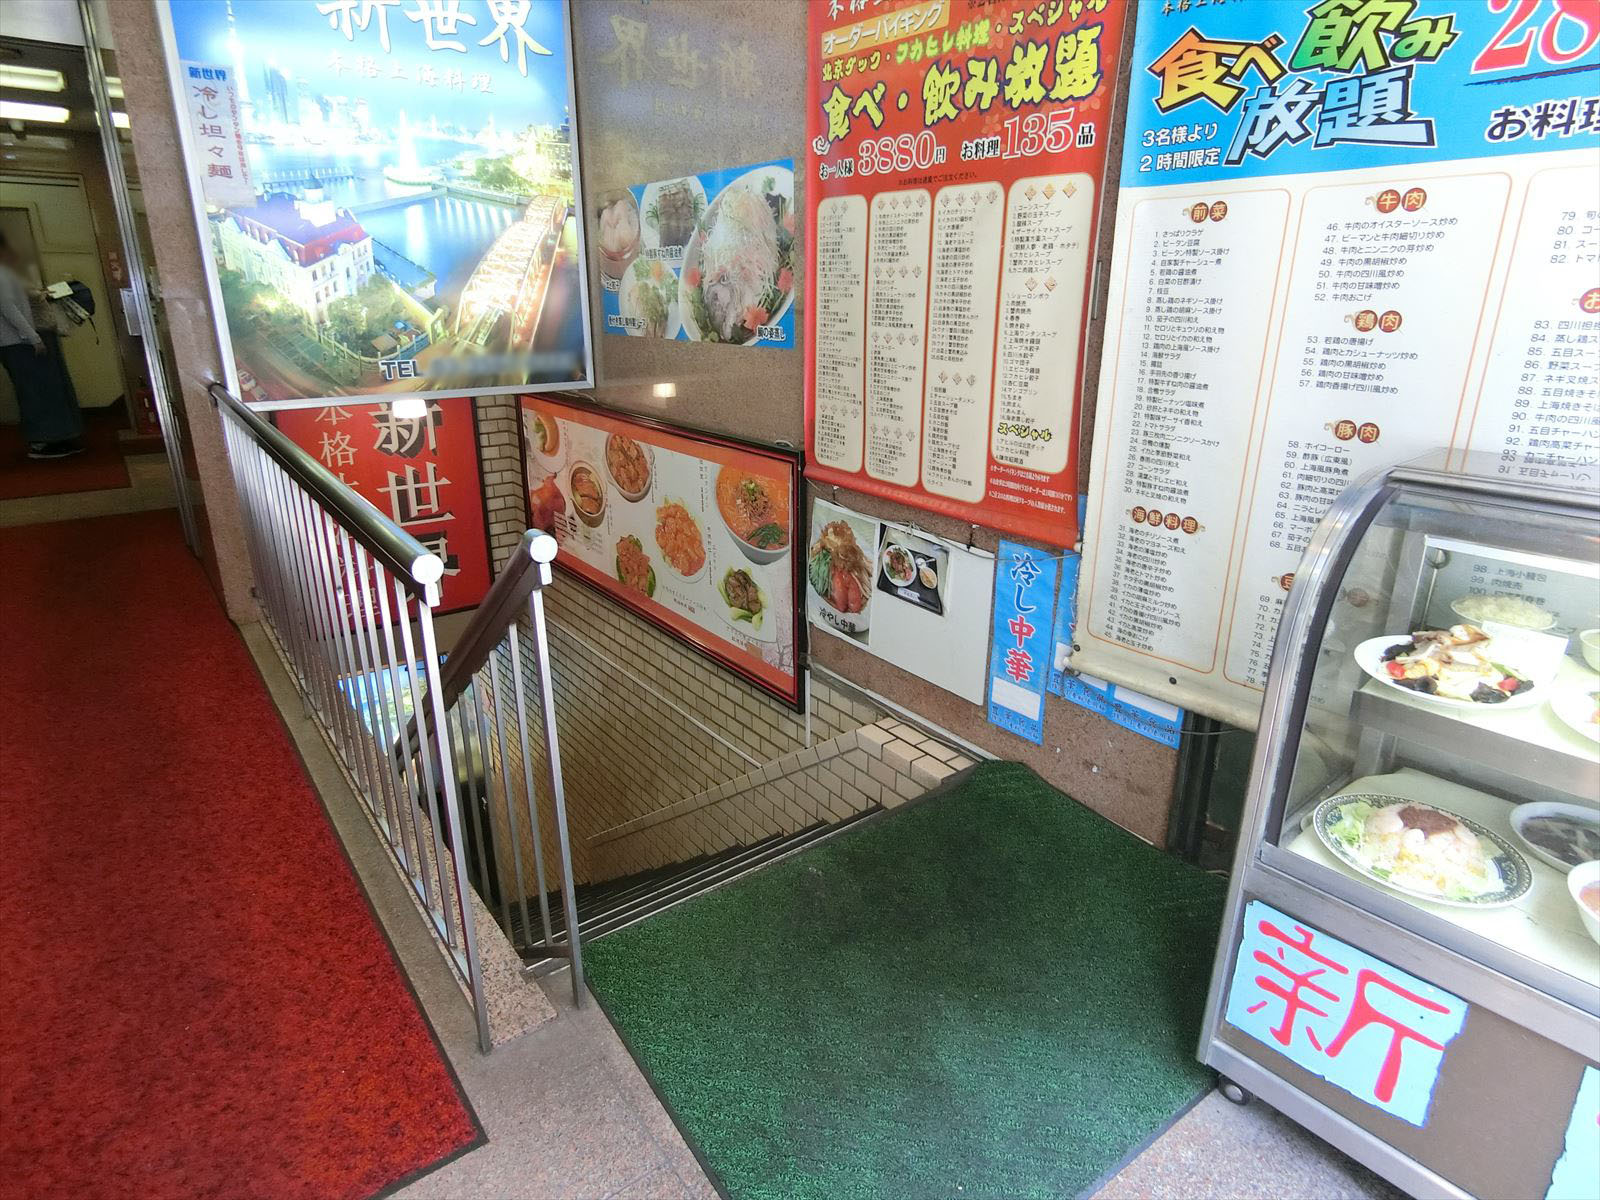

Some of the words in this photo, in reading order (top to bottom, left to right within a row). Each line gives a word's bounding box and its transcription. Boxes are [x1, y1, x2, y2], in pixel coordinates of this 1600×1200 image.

[316, 0, 553, 76] 新世界
[823, 3, 941, 54] オーダーバイキング
[326, 49, 495, 94] 本格上海料理
[821, 23, 1103, 144] 食べ・飲み放題
[1223, 64, 1438, 165] 放題
[1142, 123, 1218, 147] 3名様より
[1192, 202, 1227, 221] 前菜
[1378, 189, 1426, 212] 牛肉
[1355, 310, 1402, 332] 鶏肉
[998, 422, 1052, 442] スペシャル
[1336, 421, 1380, 442] 豚肉
[1133, 507, 1197, 533] 海鮮料理
[818, 606, 857, 633] 冷やし中華
[1005, 552, 1041, 682] 冷し中華
[1247, 920, 1451, 1103] 新
